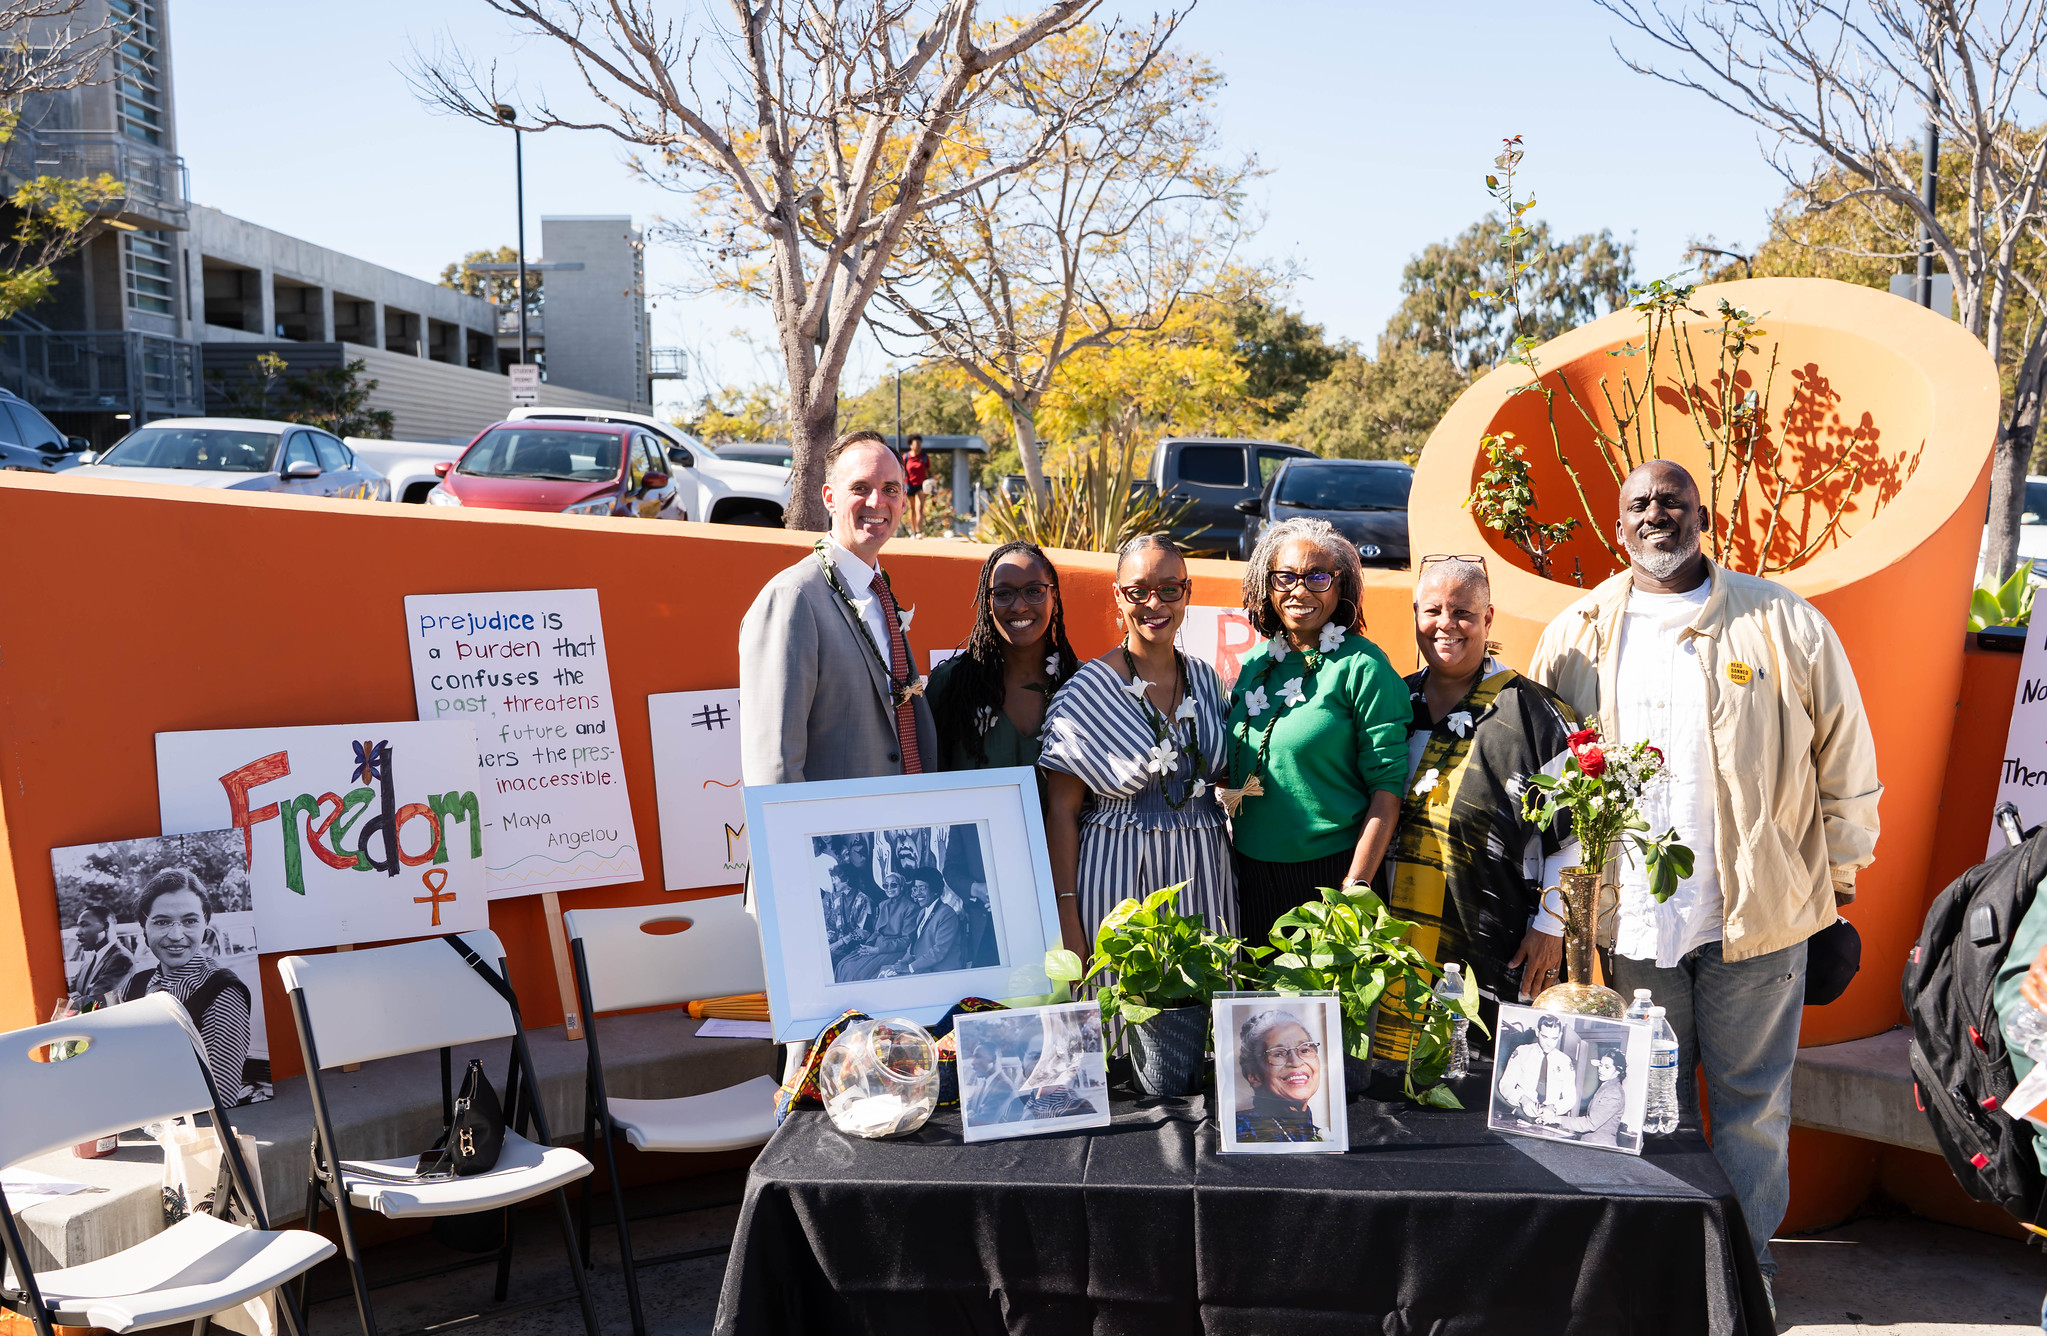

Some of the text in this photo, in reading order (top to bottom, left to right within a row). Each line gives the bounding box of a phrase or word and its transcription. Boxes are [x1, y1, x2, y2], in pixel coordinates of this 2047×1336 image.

[420, 611, 563, 637] prejudice is
[429, 635, 597, 661] a burden that
[1214, 614, 1268, 692] R
[431, 668, 584, 690] confuses the
[503, 694, 599, 712] threatens
[499, 720, 606, 744] future and
[532, 747, 567, 765] the
[573, 745, 615, 768] pres-
[496, 769, 617, 794] inaccessible.
[218, 749, 483, 896] Freedom
[503, 812, 552, 831] Maya
[548, 829, 619, 850] Angelou
